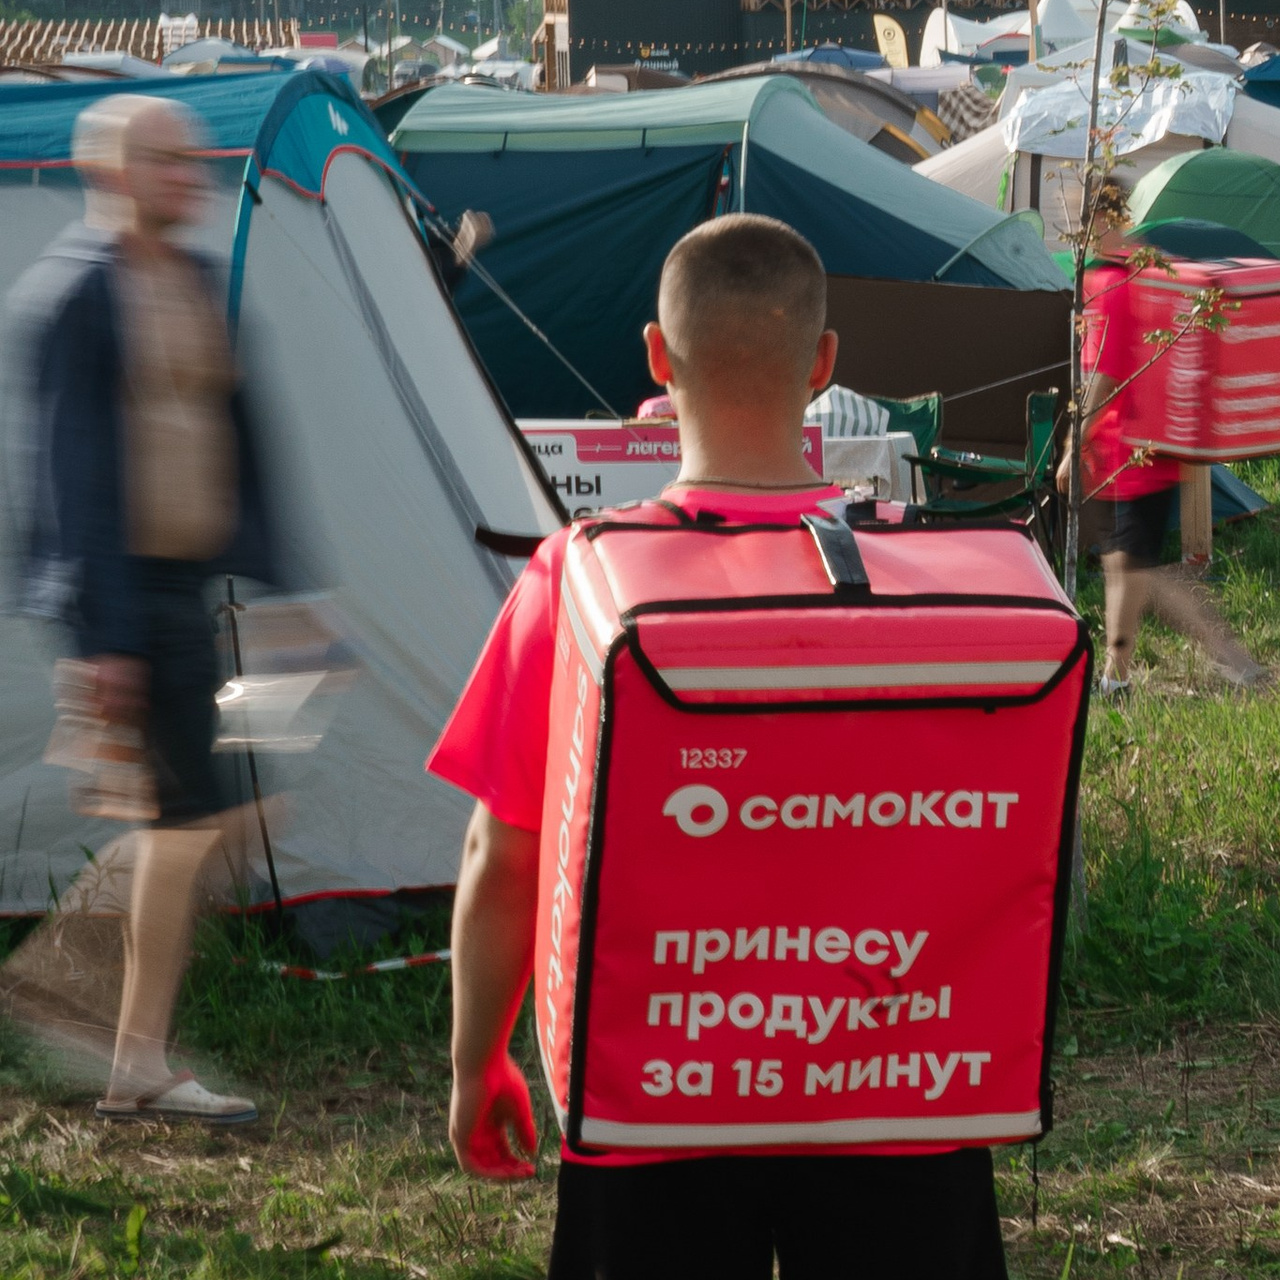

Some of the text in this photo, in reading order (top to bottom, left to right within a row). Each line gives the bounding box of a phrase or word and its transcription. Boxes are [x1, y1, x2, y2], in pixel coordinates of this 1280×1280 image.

[680, 748, 748, 769] 12337
[739, 789, 1019, 829] самокат
[546, 664, 589, 1074] samokat.ru
[653, 925, 929, 977] принесу
[647, 984, 952, 1043] продукты
[641, 1050, 992, 1101] за 15 минут
